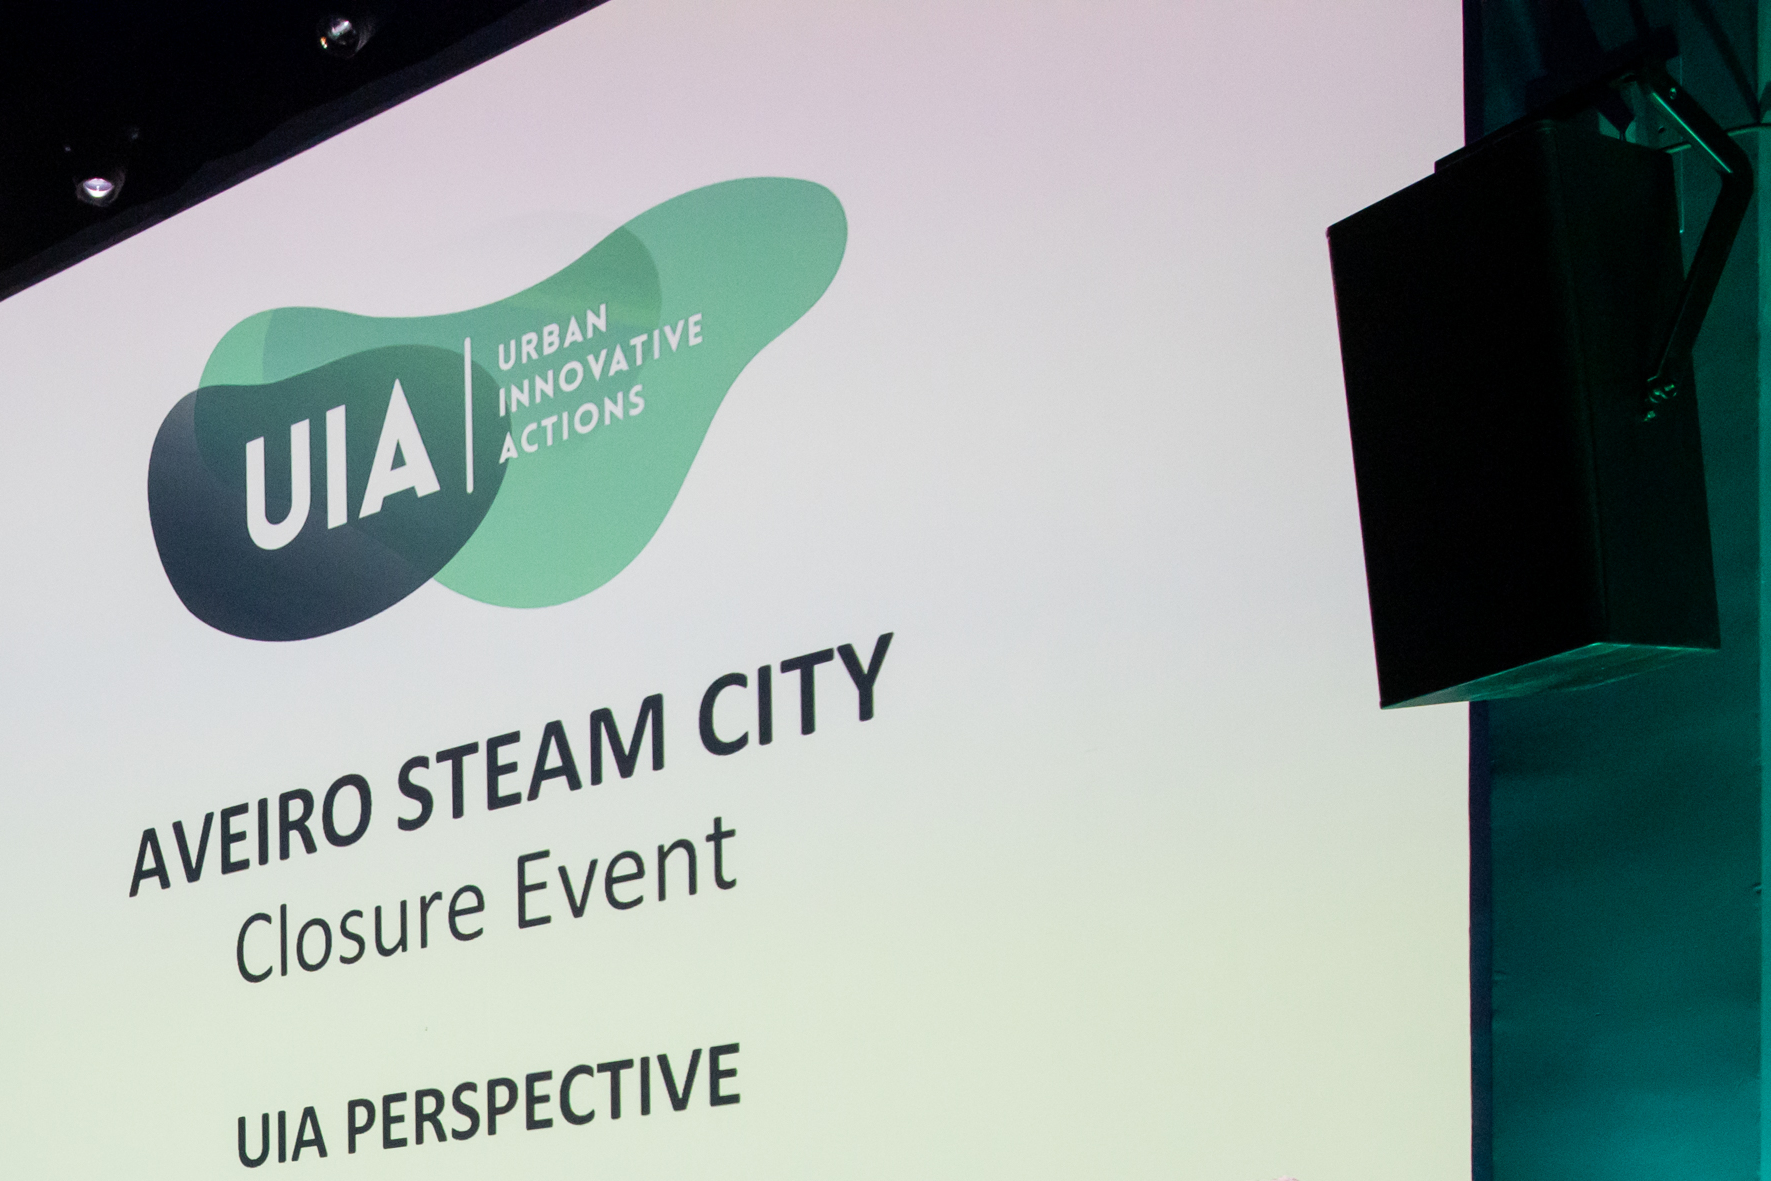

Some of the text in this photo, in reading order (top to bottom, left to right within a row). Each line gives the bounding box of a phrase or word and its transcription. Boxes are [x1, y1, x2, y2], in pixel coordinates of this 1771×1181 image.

[498, 303, 608, 372] URBAN
[498, 312, 705, 418] INNOVATIVE
[245, 378, 441, 551] UIA
[498, 383, 646, 465] ACTIONS
[129, 631, 895, 898] AVEIRO STEAM CITY
[236, 816, 738, 984] Closure Event
[237, 1042, 741, 1169] UIA PERSPECTIVE
